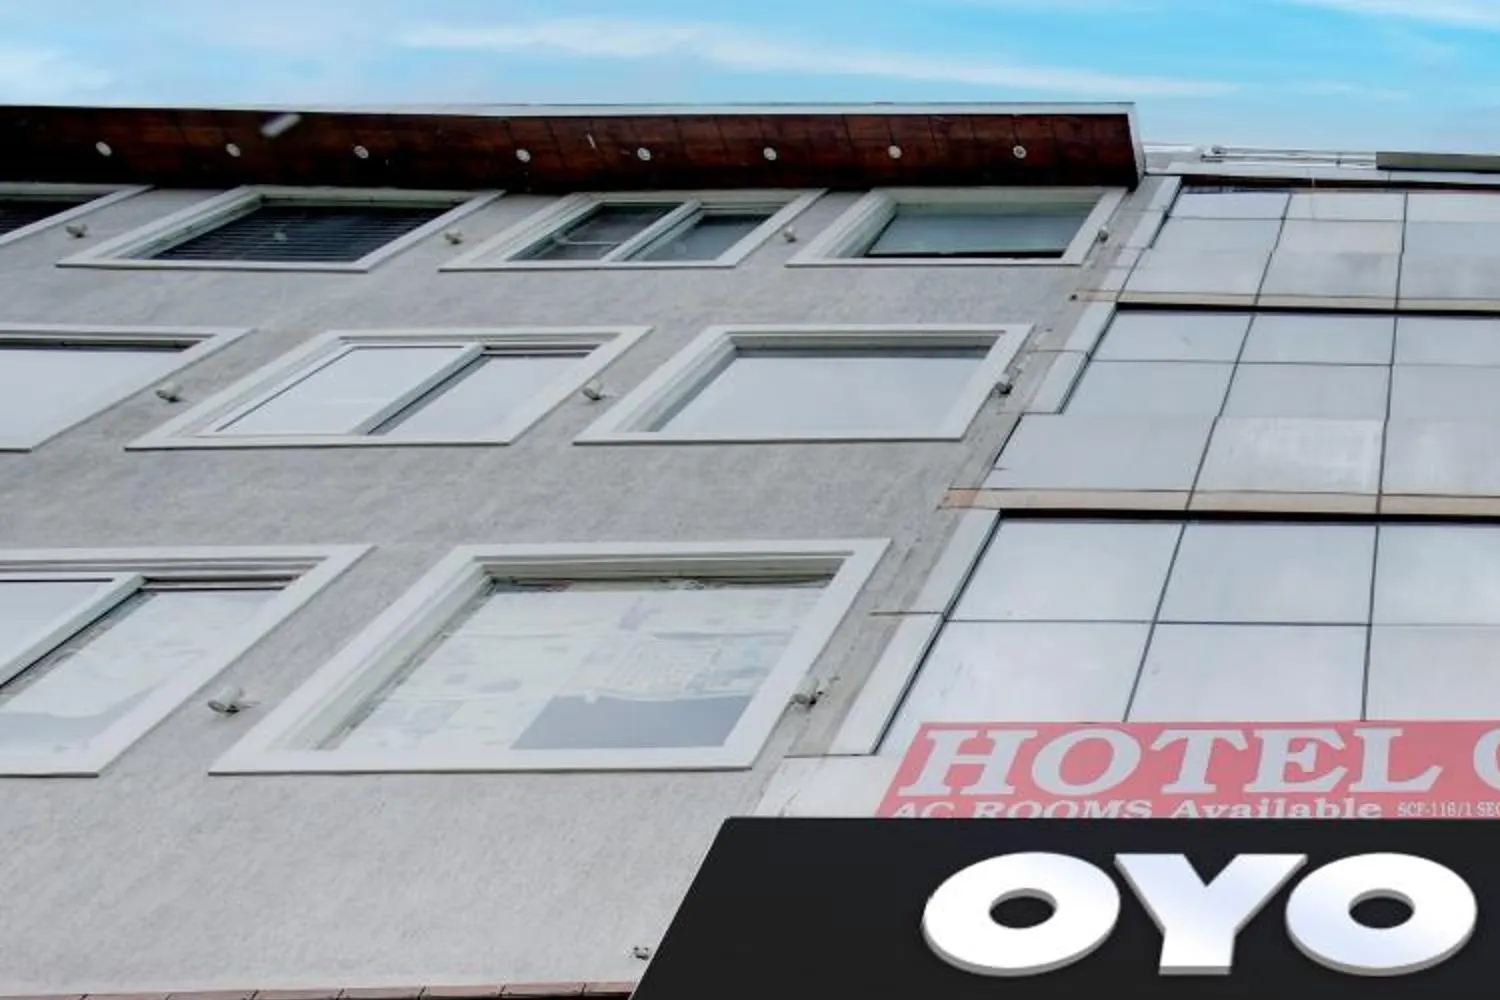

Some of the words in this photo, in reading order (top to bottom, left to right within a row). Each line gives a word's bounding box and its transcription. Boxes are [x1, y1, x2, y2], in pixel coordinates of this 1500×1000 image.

[896, 727, 1443, 796] HOTEL
[892, 801, 955, 819] AC
[972, 799, 1154, 819] ROOMS
[1165, 797, 1383, 819] Available
[921, 851, 1478, 977] OYO
